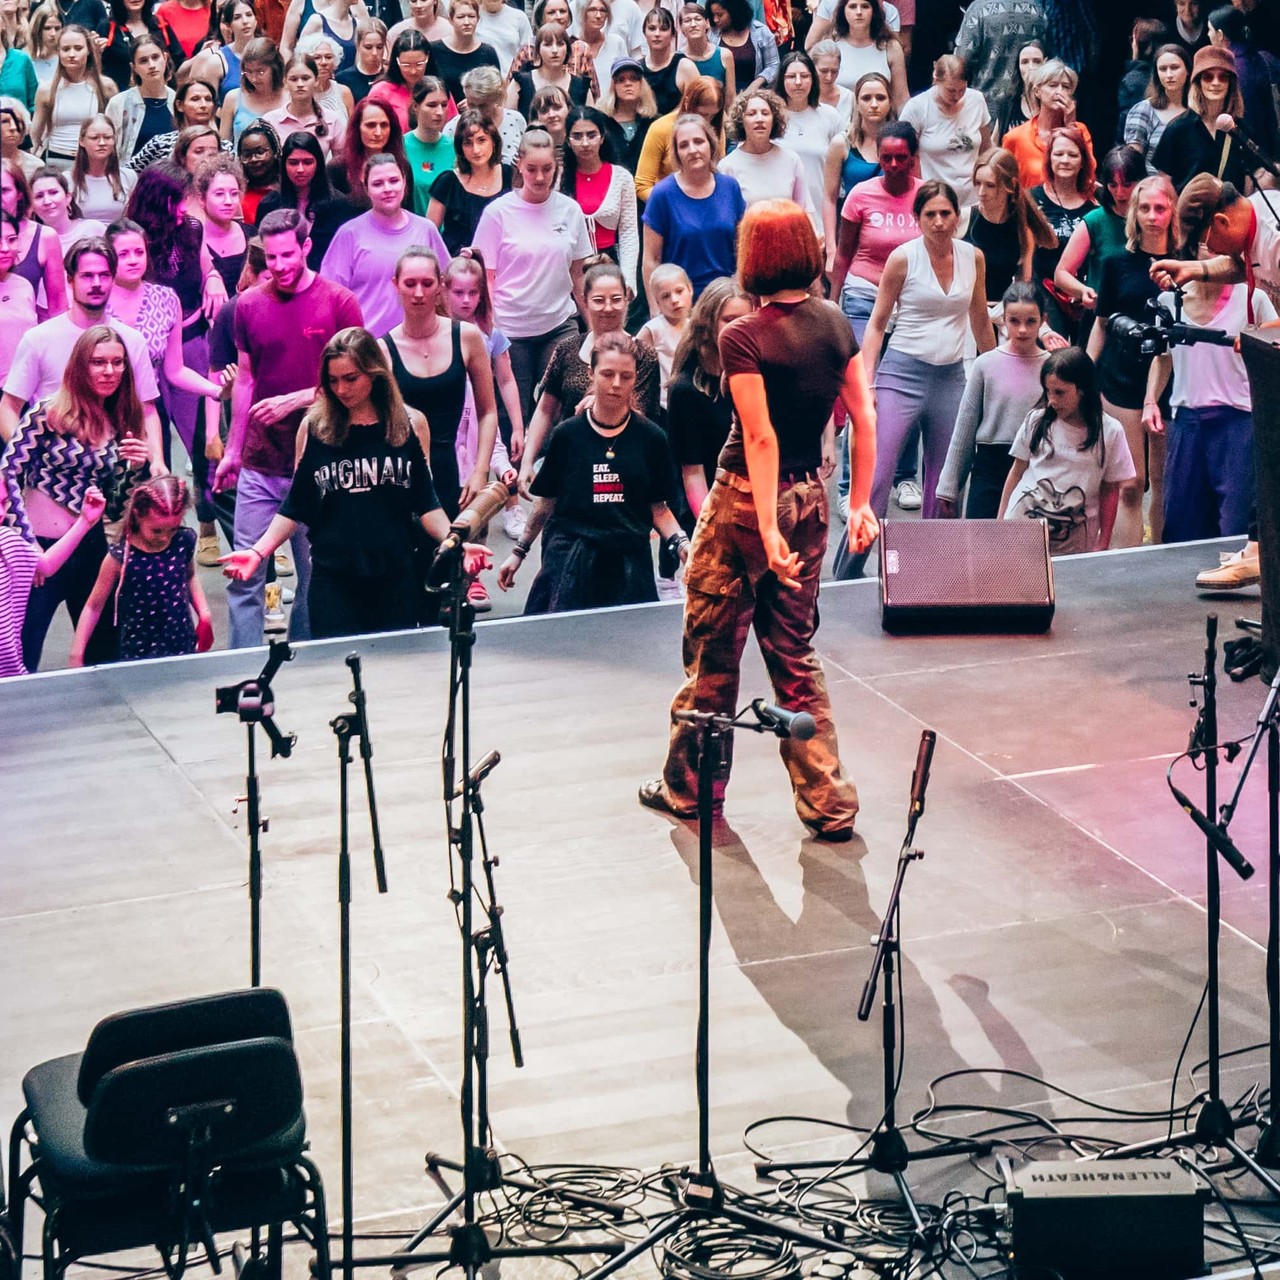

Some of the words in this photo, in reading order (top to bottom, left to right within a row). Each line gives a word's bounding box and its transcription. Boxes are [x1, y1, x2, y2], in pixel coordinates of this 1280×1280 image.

[886, 213, 919, 227] ROX
[593, 463, 610, 473] EAT.
[593, 473, 620, 483] SLEEP.
[593, 493, 625, 503] REPEAT.
[1031, 1171, 1173, 1183] ALLEN&HEATH
